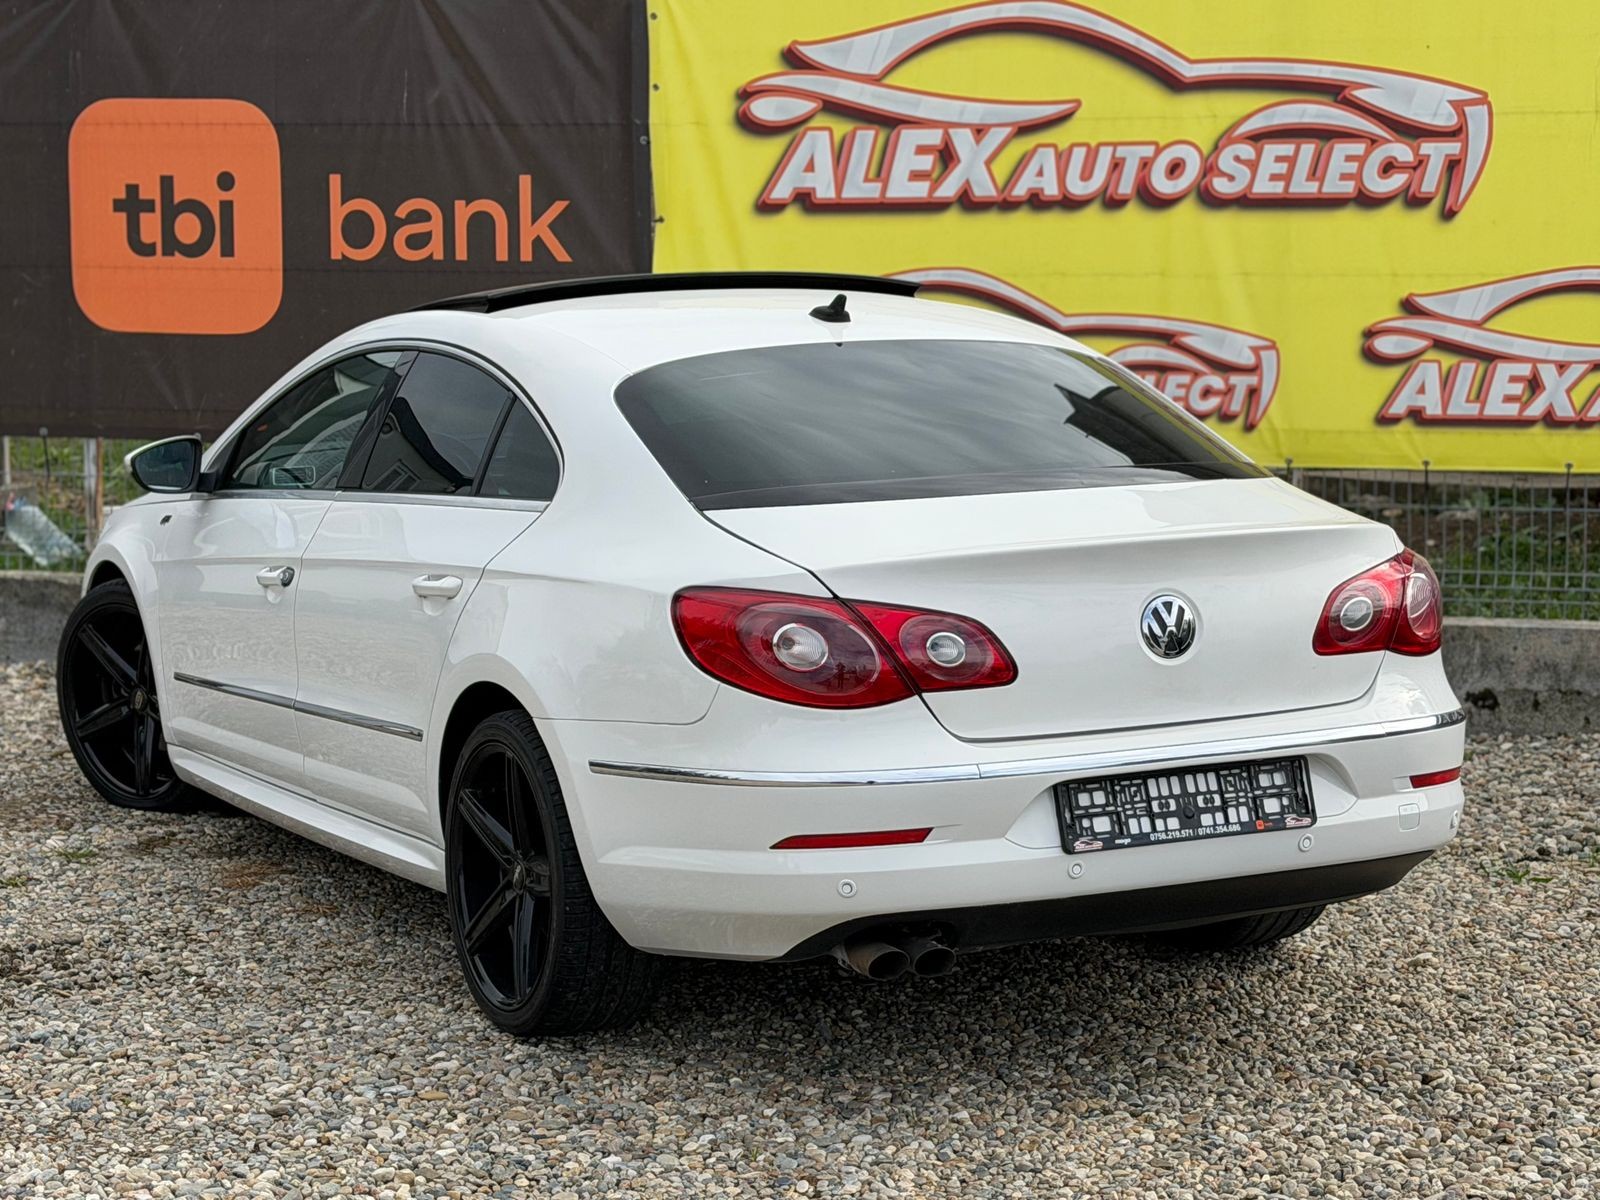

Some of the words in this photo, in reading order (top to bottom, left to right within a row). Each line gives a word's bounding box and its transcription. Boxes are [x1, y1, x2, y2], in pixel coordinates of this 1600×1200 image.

[764, 127, 1015, 201] ALEX
[1007, 142, 1203, 199] AUTO
[1209, 140, 1463, 199] SELECT
[113, 171, 235, 258] tbi
[329, 174, 573, 262] bank
[1384, 361, 1593, 418] ALEX
